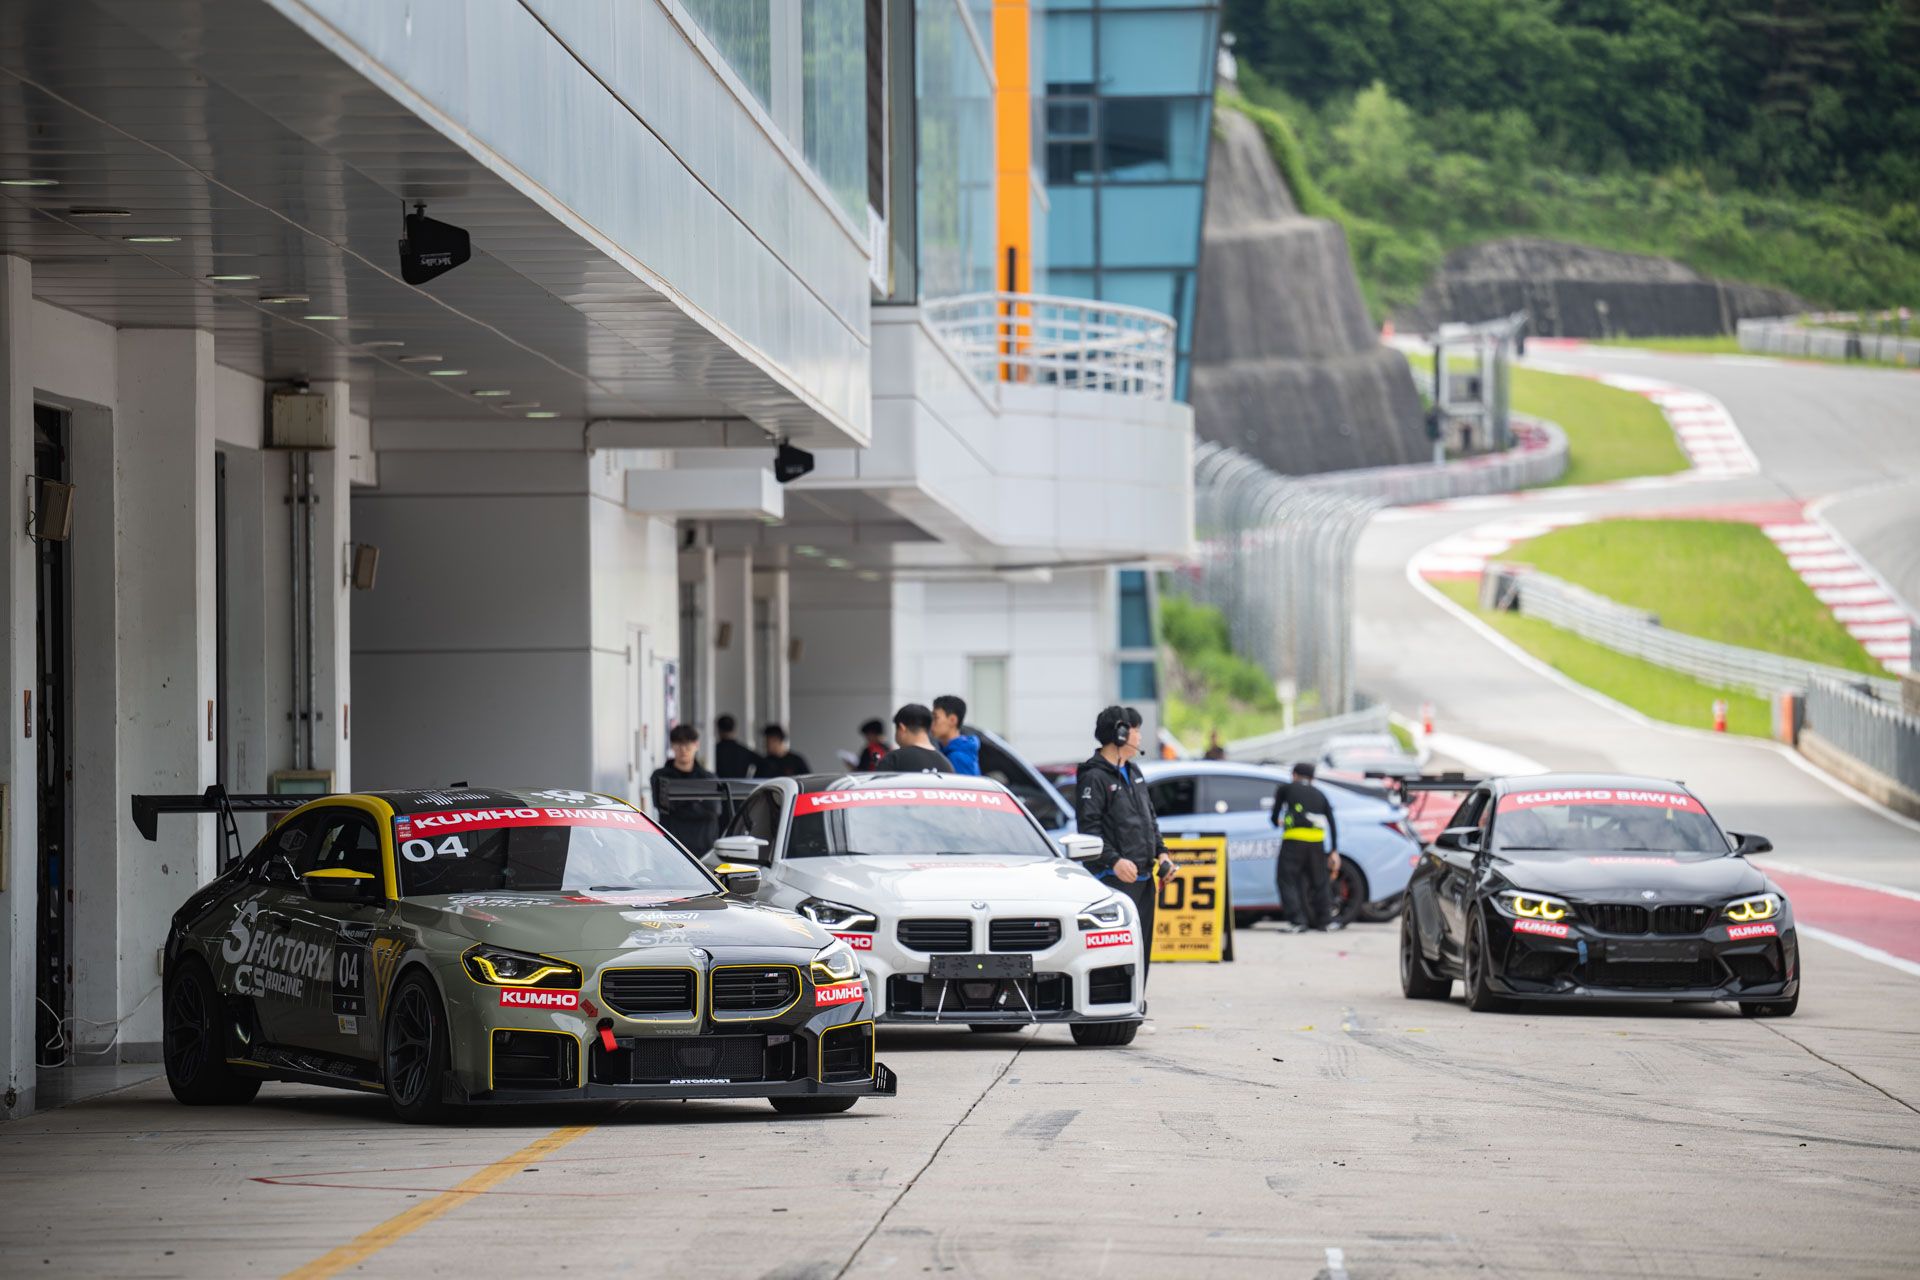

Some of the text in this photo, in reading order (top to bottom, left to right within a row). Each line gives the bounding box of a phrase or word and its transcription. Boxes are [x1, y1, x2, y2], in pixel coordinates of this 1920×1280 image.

[811, 791, 1001, 806] KUMHO BMW M
[1516, 790, 1688, 806] KUMHO BMW M
[413, 808, 539, 829] KUMHO
[547, 808, 608, 821] BMW
[612, 814, 636, 824] M
[401, 835, 469, 862] 04
[1158, 876, 1216, 910] 05
[1515, 920, 1567, 936] KUMHO
[1729, 924, 1776, 938] KUMHO
[1087, 932, 1133, 946] KUMHO
[339, 951, 359, 988] 04
[264, 971, 303, 997] RACING
[502, 991, 577, 1006] KUMHO
[817, 987, 863, 1002] KUMHO
